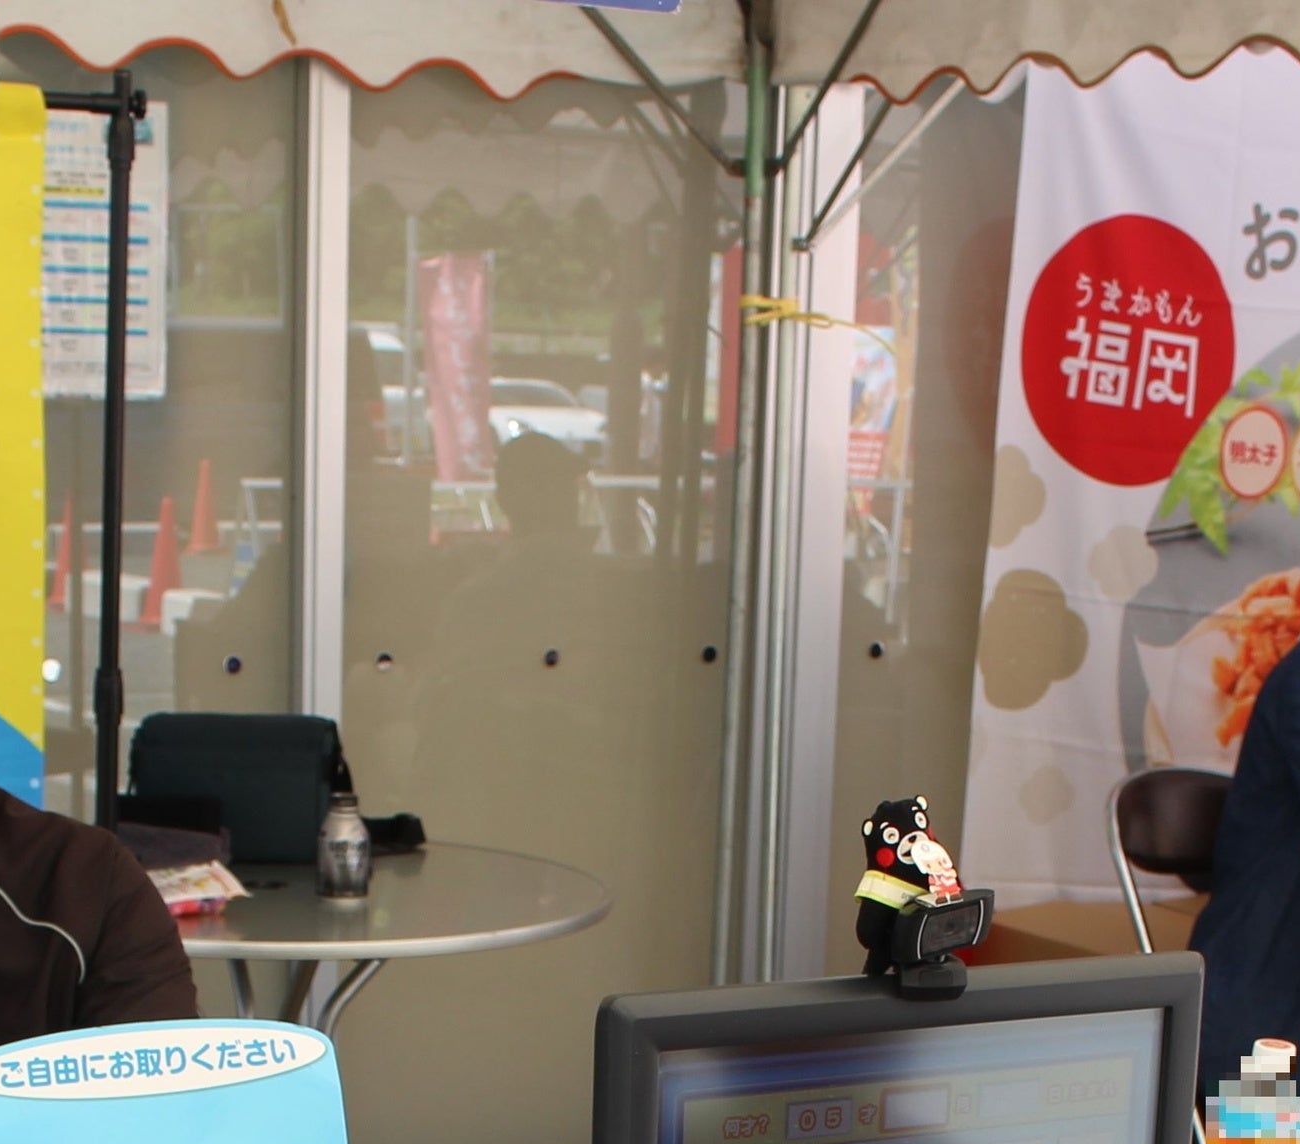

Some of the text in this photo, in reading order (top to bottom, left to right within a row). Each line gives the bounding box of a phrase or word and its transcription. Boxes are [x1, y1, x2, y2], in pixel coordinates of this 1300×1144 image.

[1060, 316, 1199, 418] 福岡
[0, 1039, 297, 1089] ご自由にお取りください
